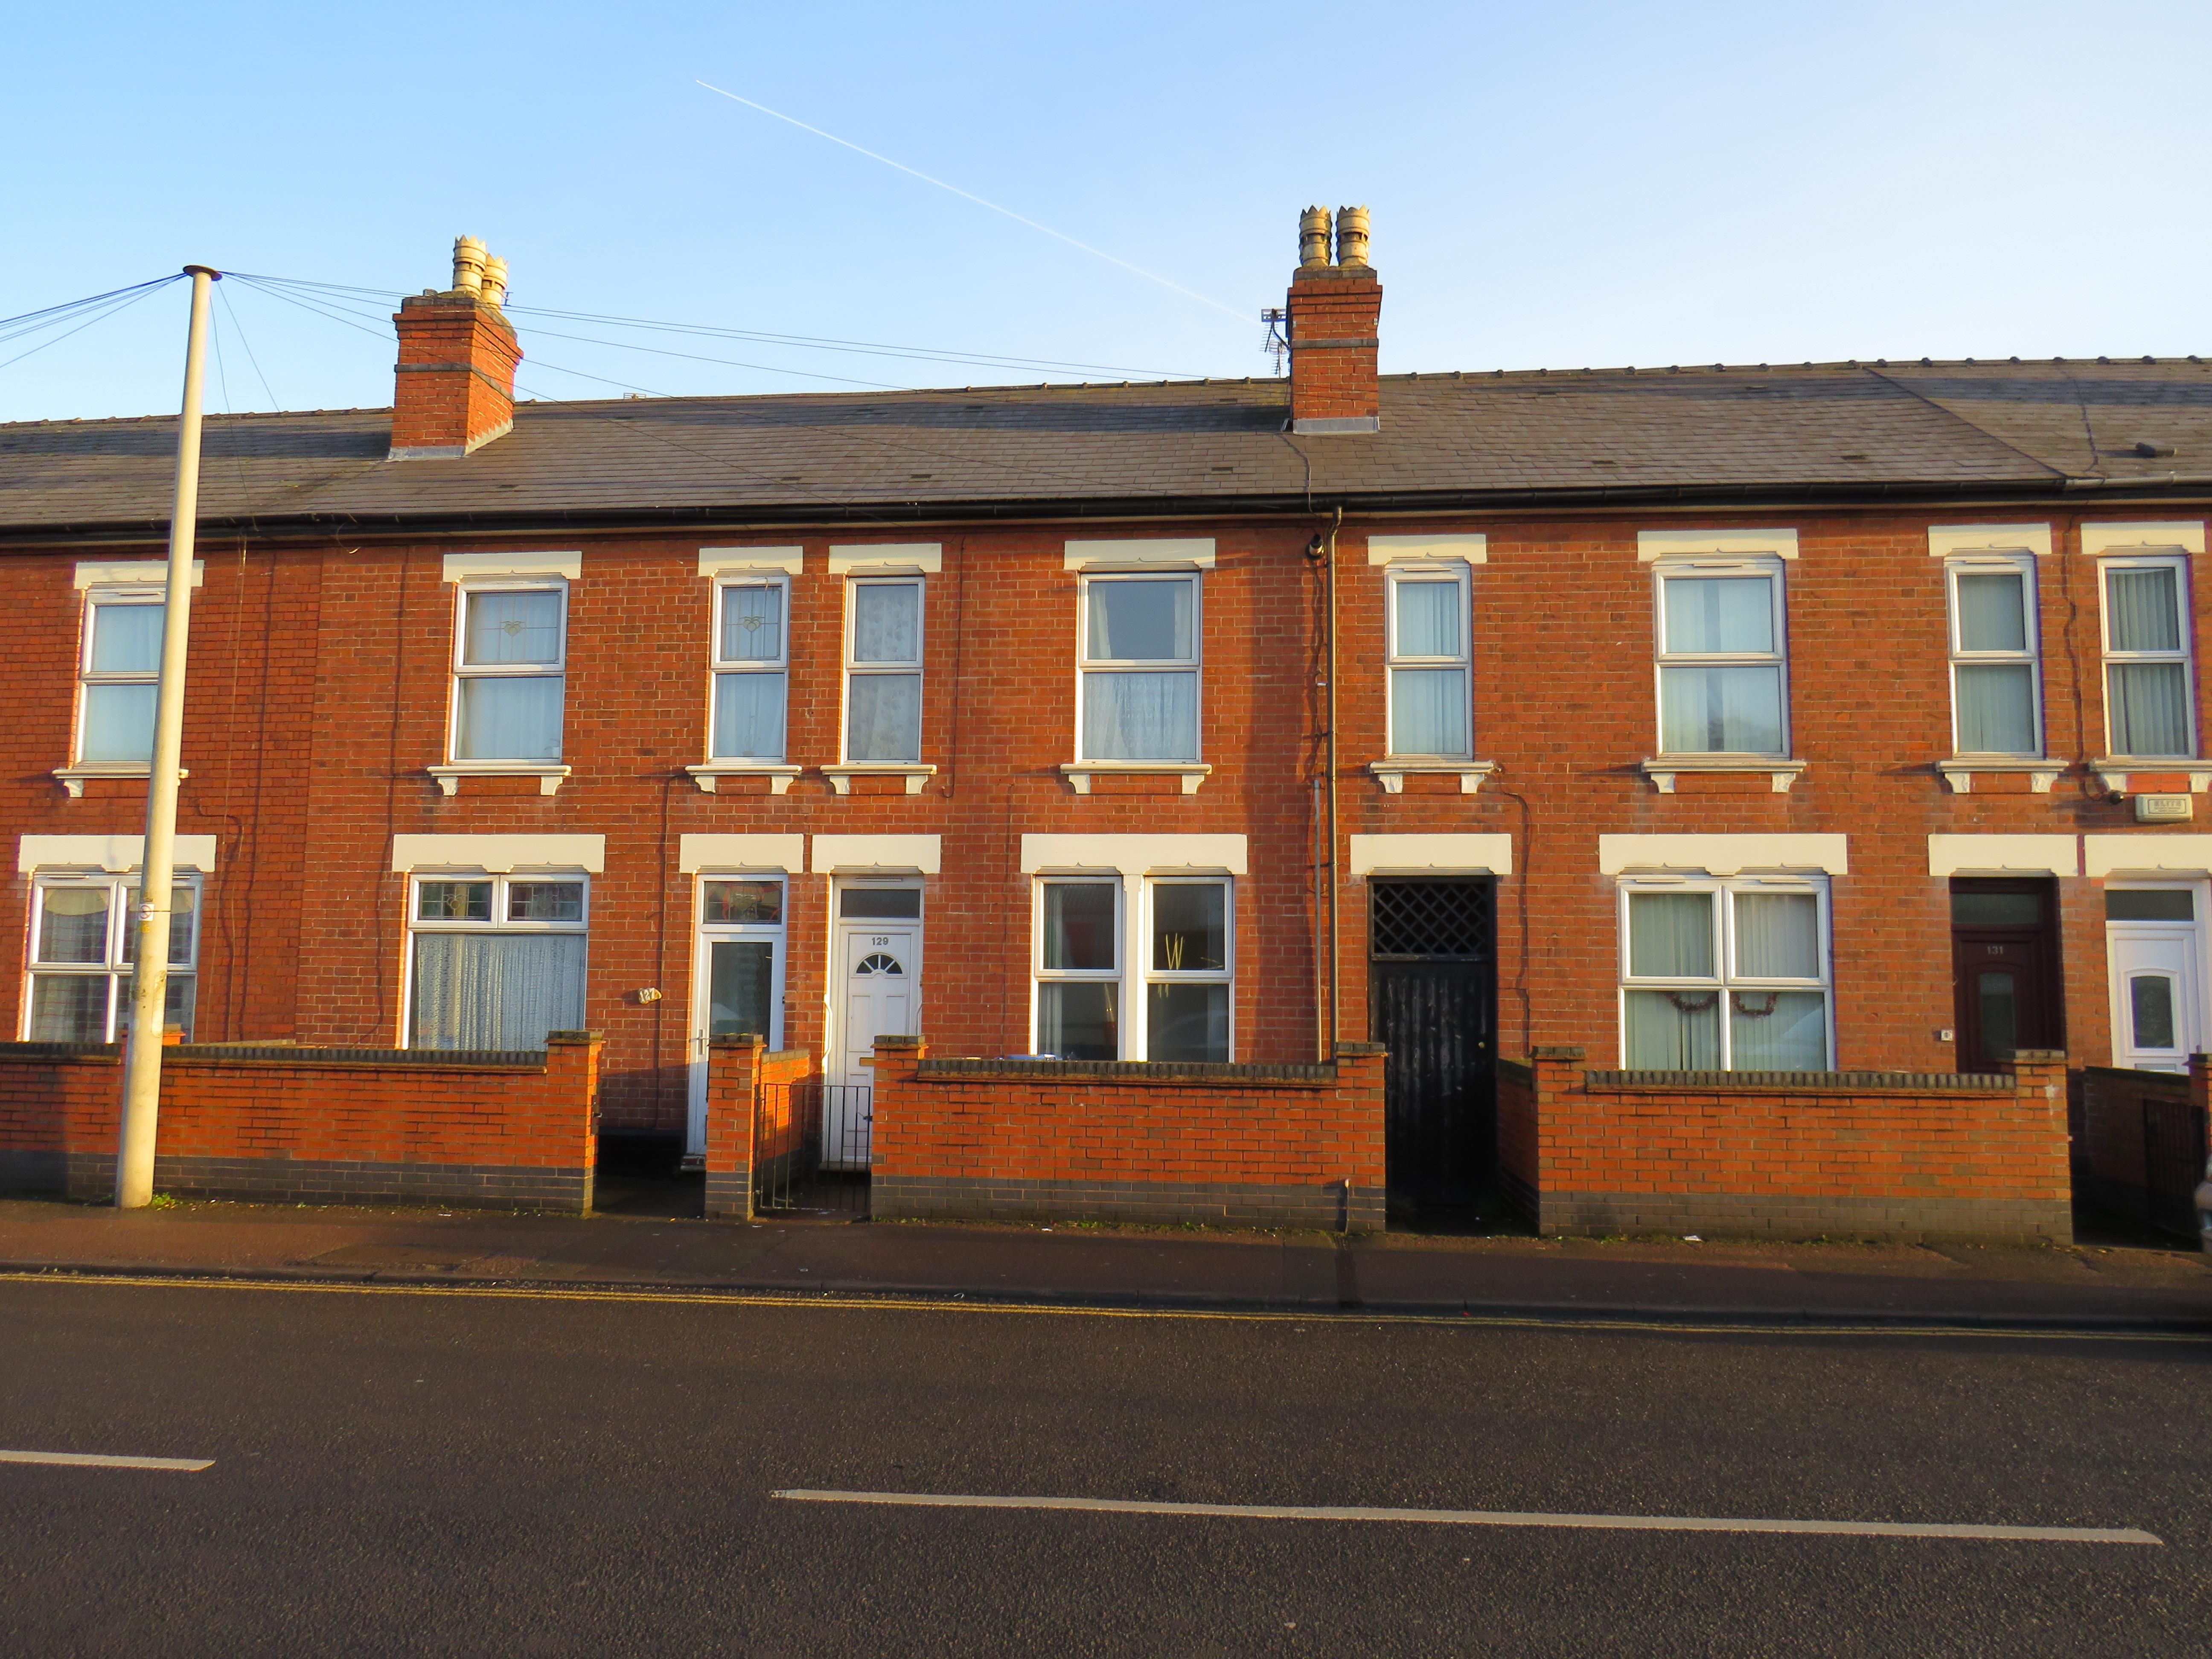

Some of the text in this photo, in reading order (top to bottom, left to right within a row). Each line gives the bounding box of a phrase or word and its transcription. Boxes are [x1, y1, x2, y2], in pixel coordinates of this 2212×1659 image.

[872, 937, 888, 945] 129
[1987, 946, 2004, 954] 131
[639, 987, 655, 1003] 127
